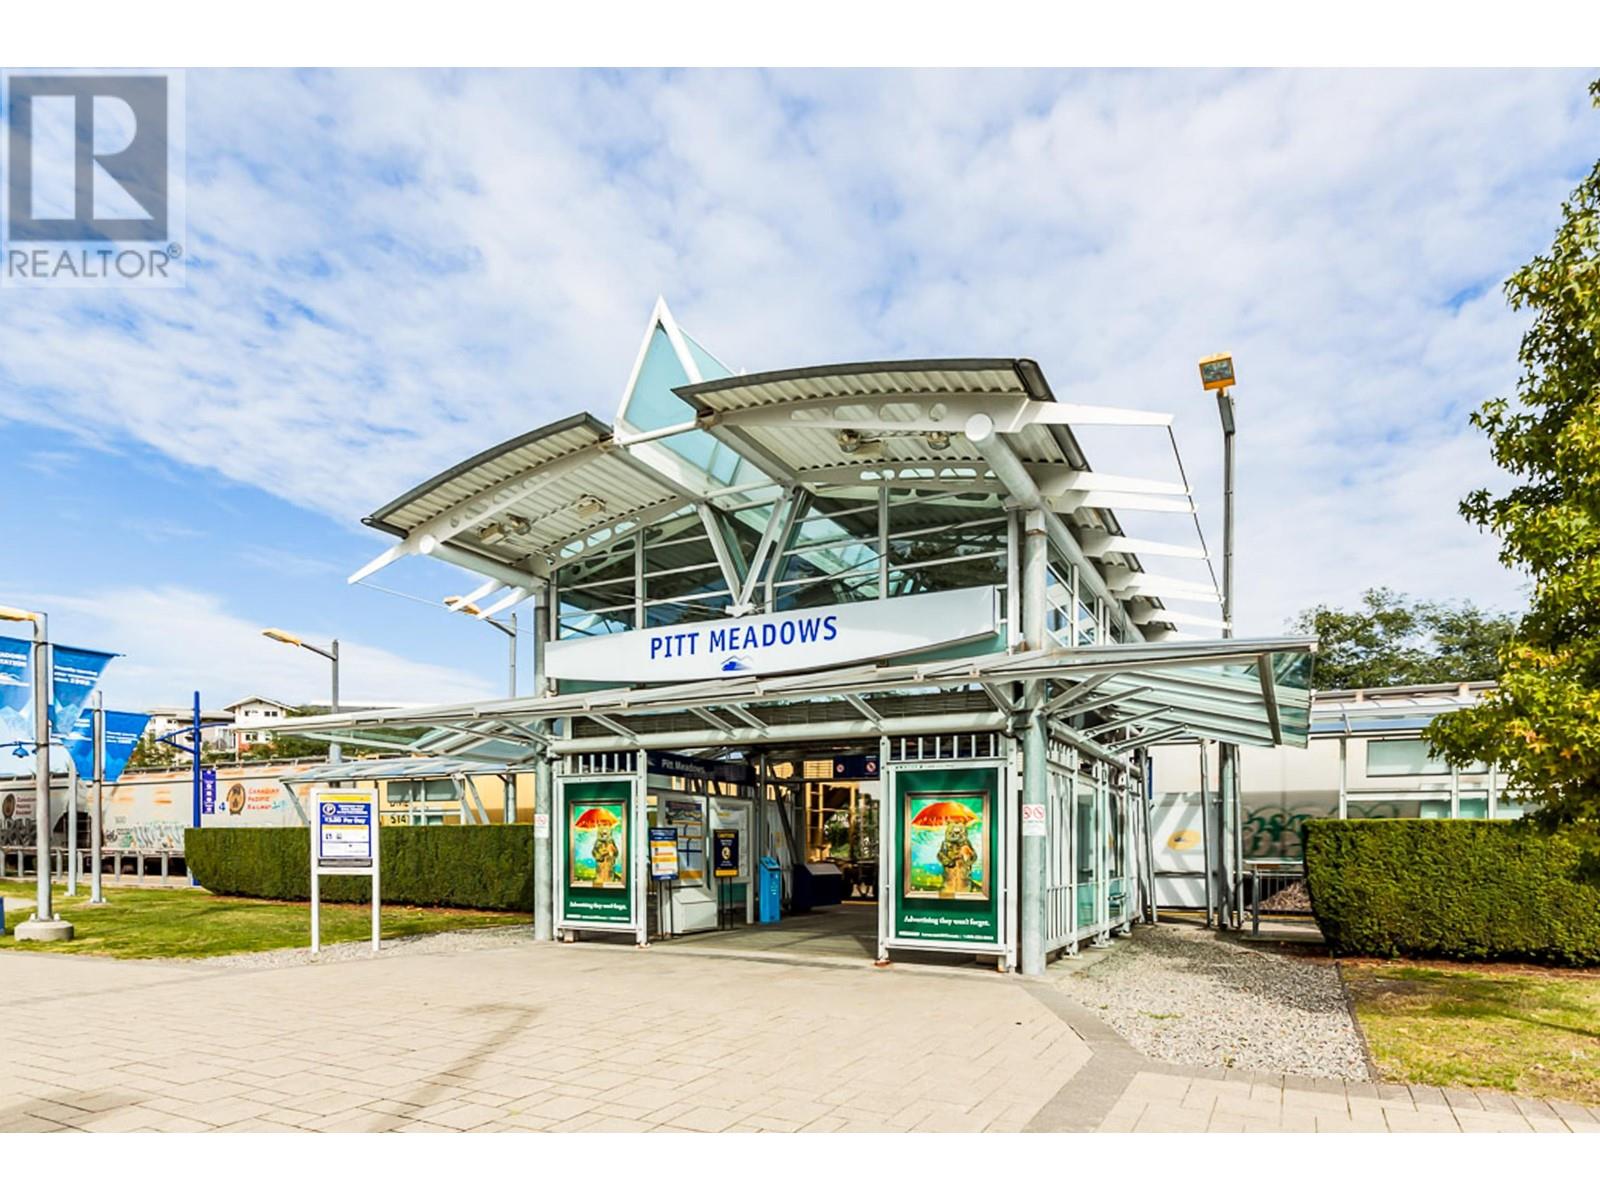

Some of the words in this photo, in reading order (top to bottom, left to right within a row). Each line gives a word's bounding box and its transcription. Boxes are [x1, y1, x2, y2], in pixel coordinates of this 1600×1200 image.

[651, 632, 700, 660] PITT
[709, 615, 837, 653] MEADOWS
[903, 914, 939, 926] Advertising
[939, 916, 952, 927] they
[952, 917, 969, 926] won't
[969, 917, 991, 929] forget.
